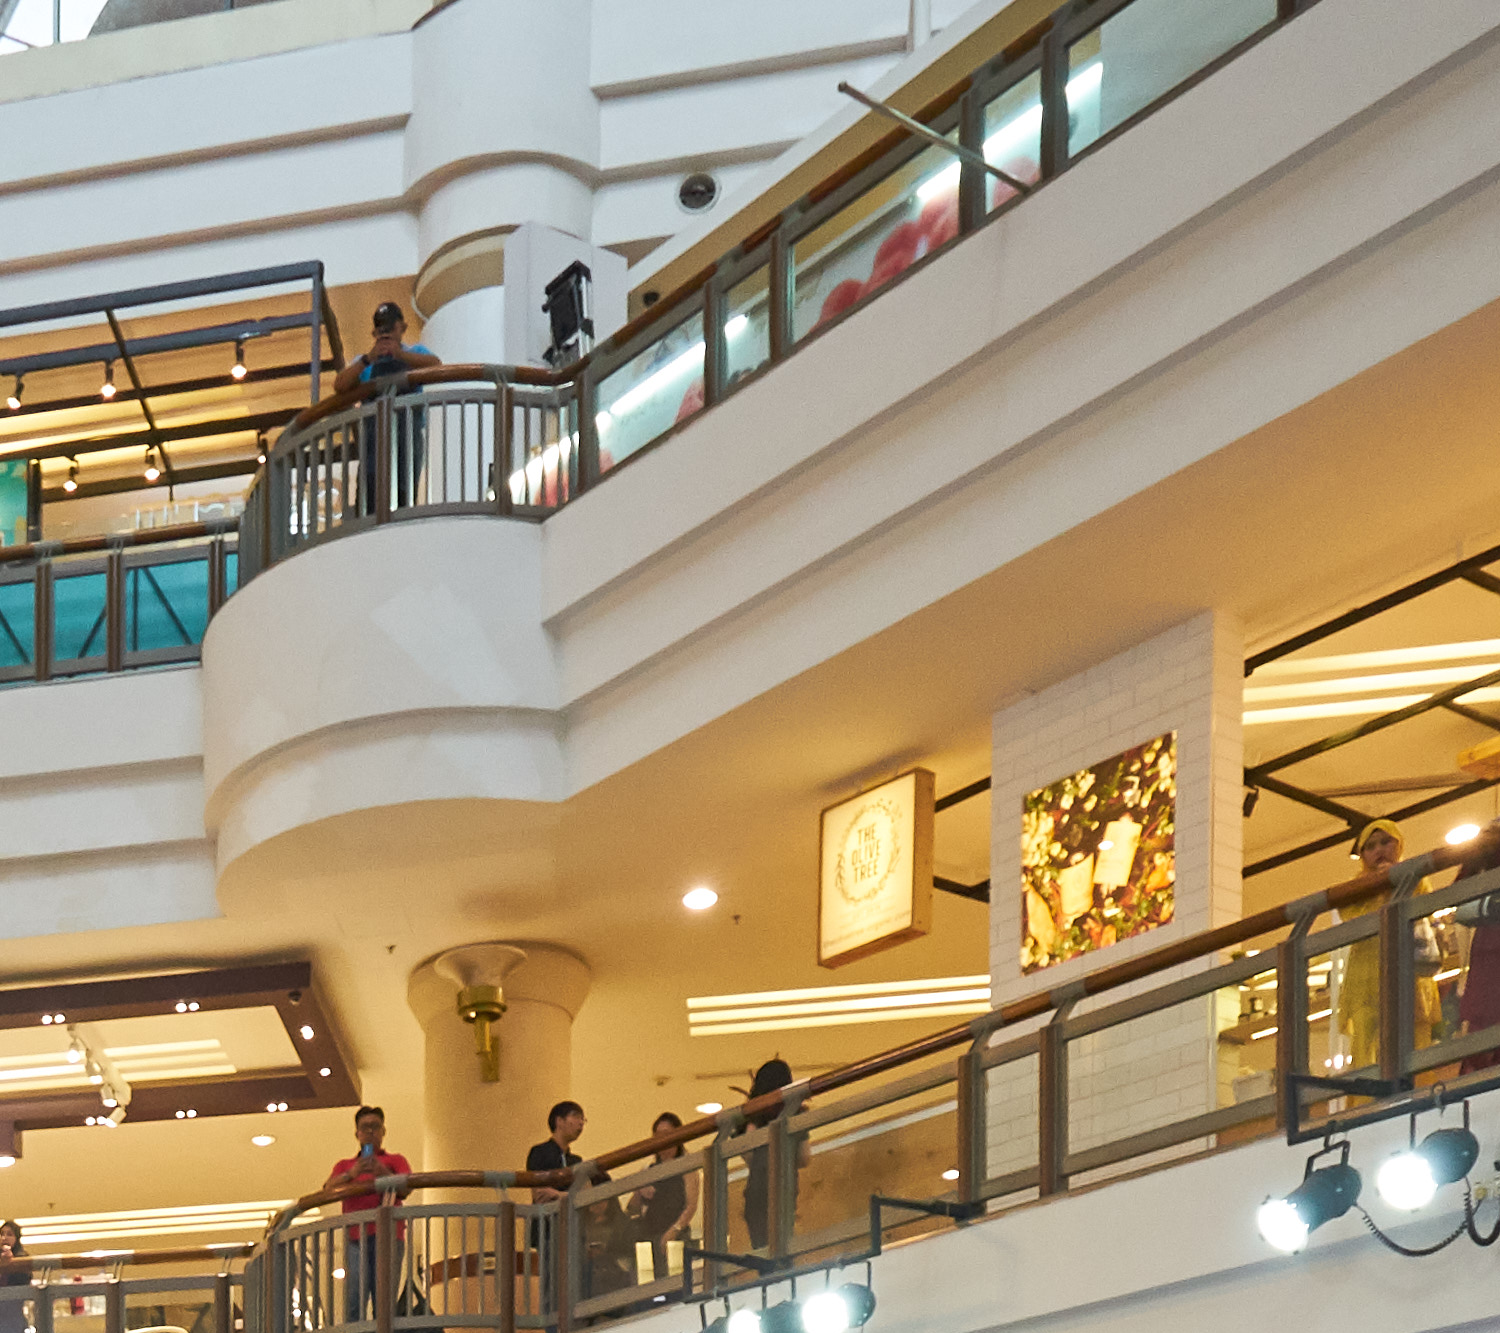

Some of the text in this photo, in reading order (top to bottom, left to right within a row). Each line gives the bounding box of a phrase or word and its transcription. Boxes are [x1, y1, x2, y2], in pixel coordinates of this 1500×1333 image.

[857, 822, 877, 843] THE
[851, 839, 881, 866] OLIVE
[853, 860, 878, 884] TREE
